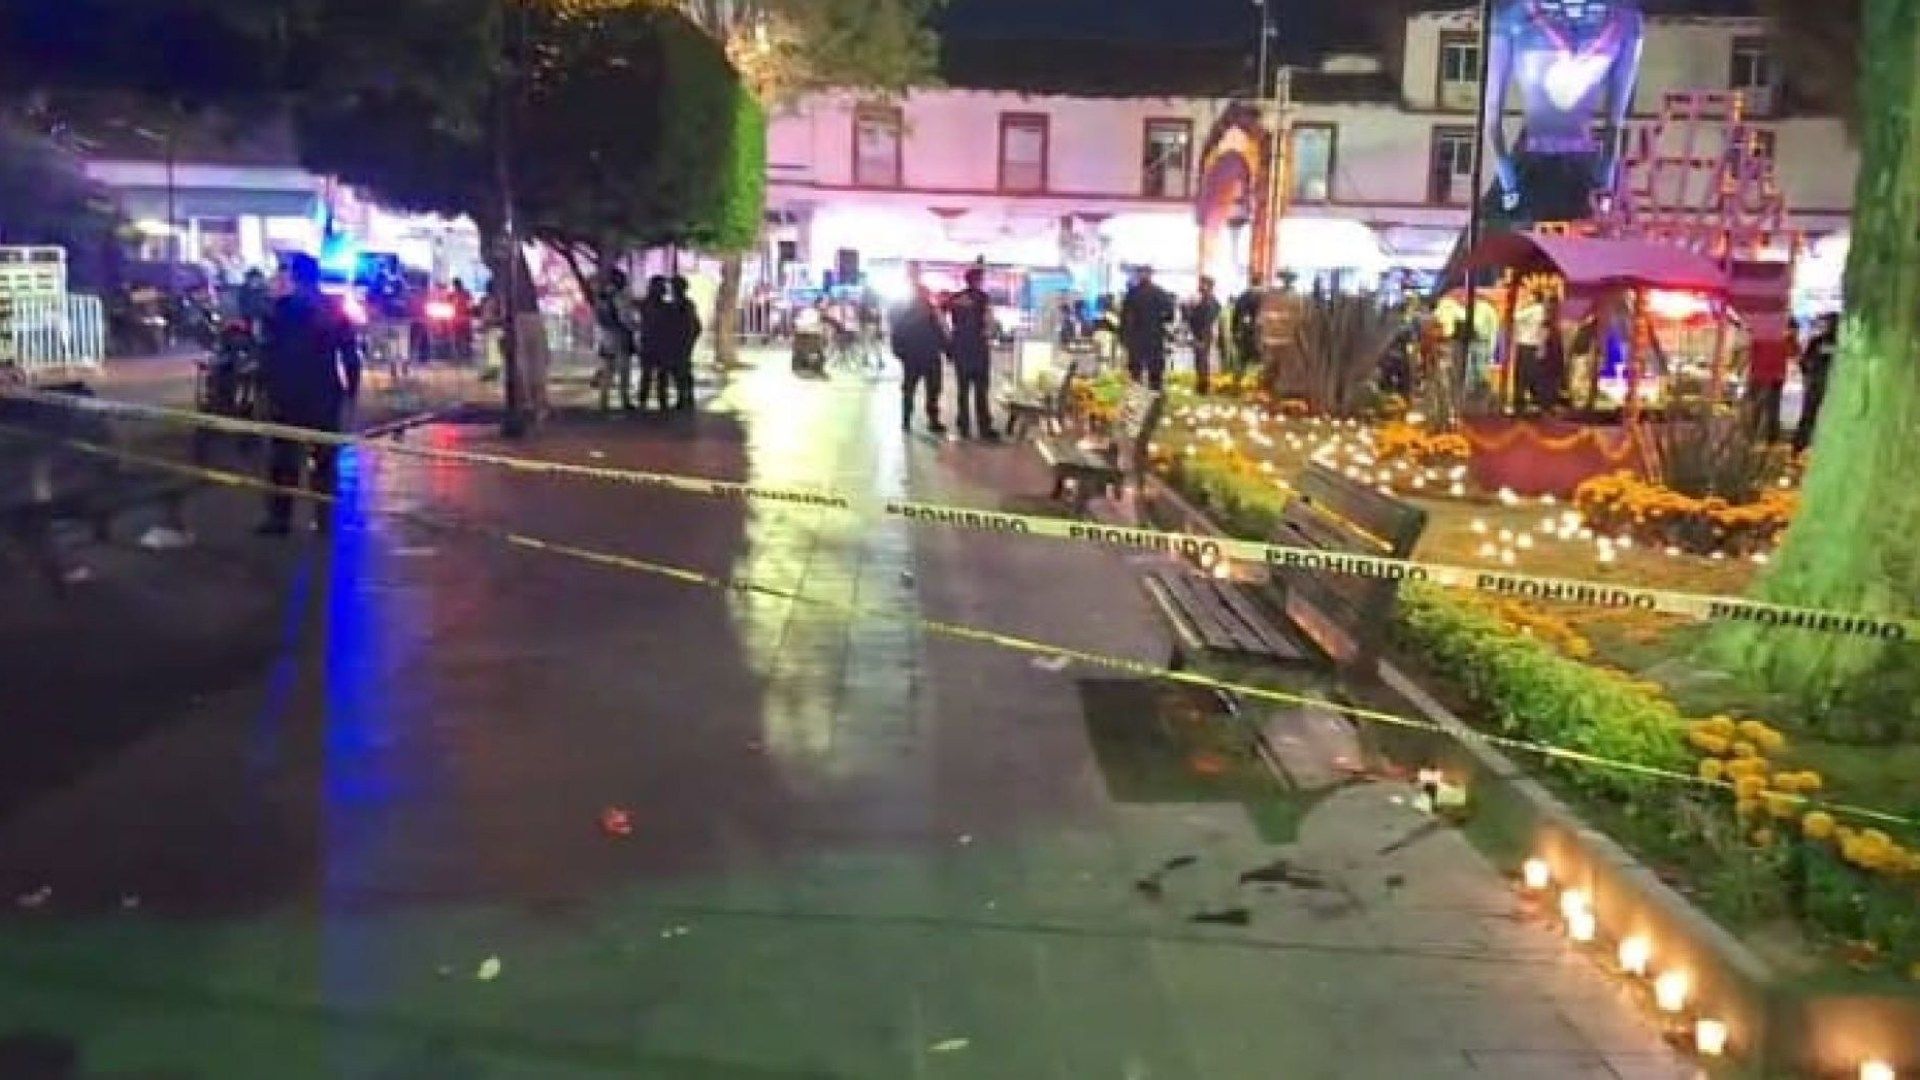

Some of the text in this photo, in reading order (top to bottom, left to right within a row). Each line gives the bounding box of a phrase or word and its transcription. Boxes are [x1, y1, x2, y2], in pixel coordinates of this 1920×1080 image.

[1069, 526, 1220, 563] PROHIBIDO
[1265, 549, 1428, 581] PROHIBIDO
[1477, 574, 1656, 610] PROHIBIDO
